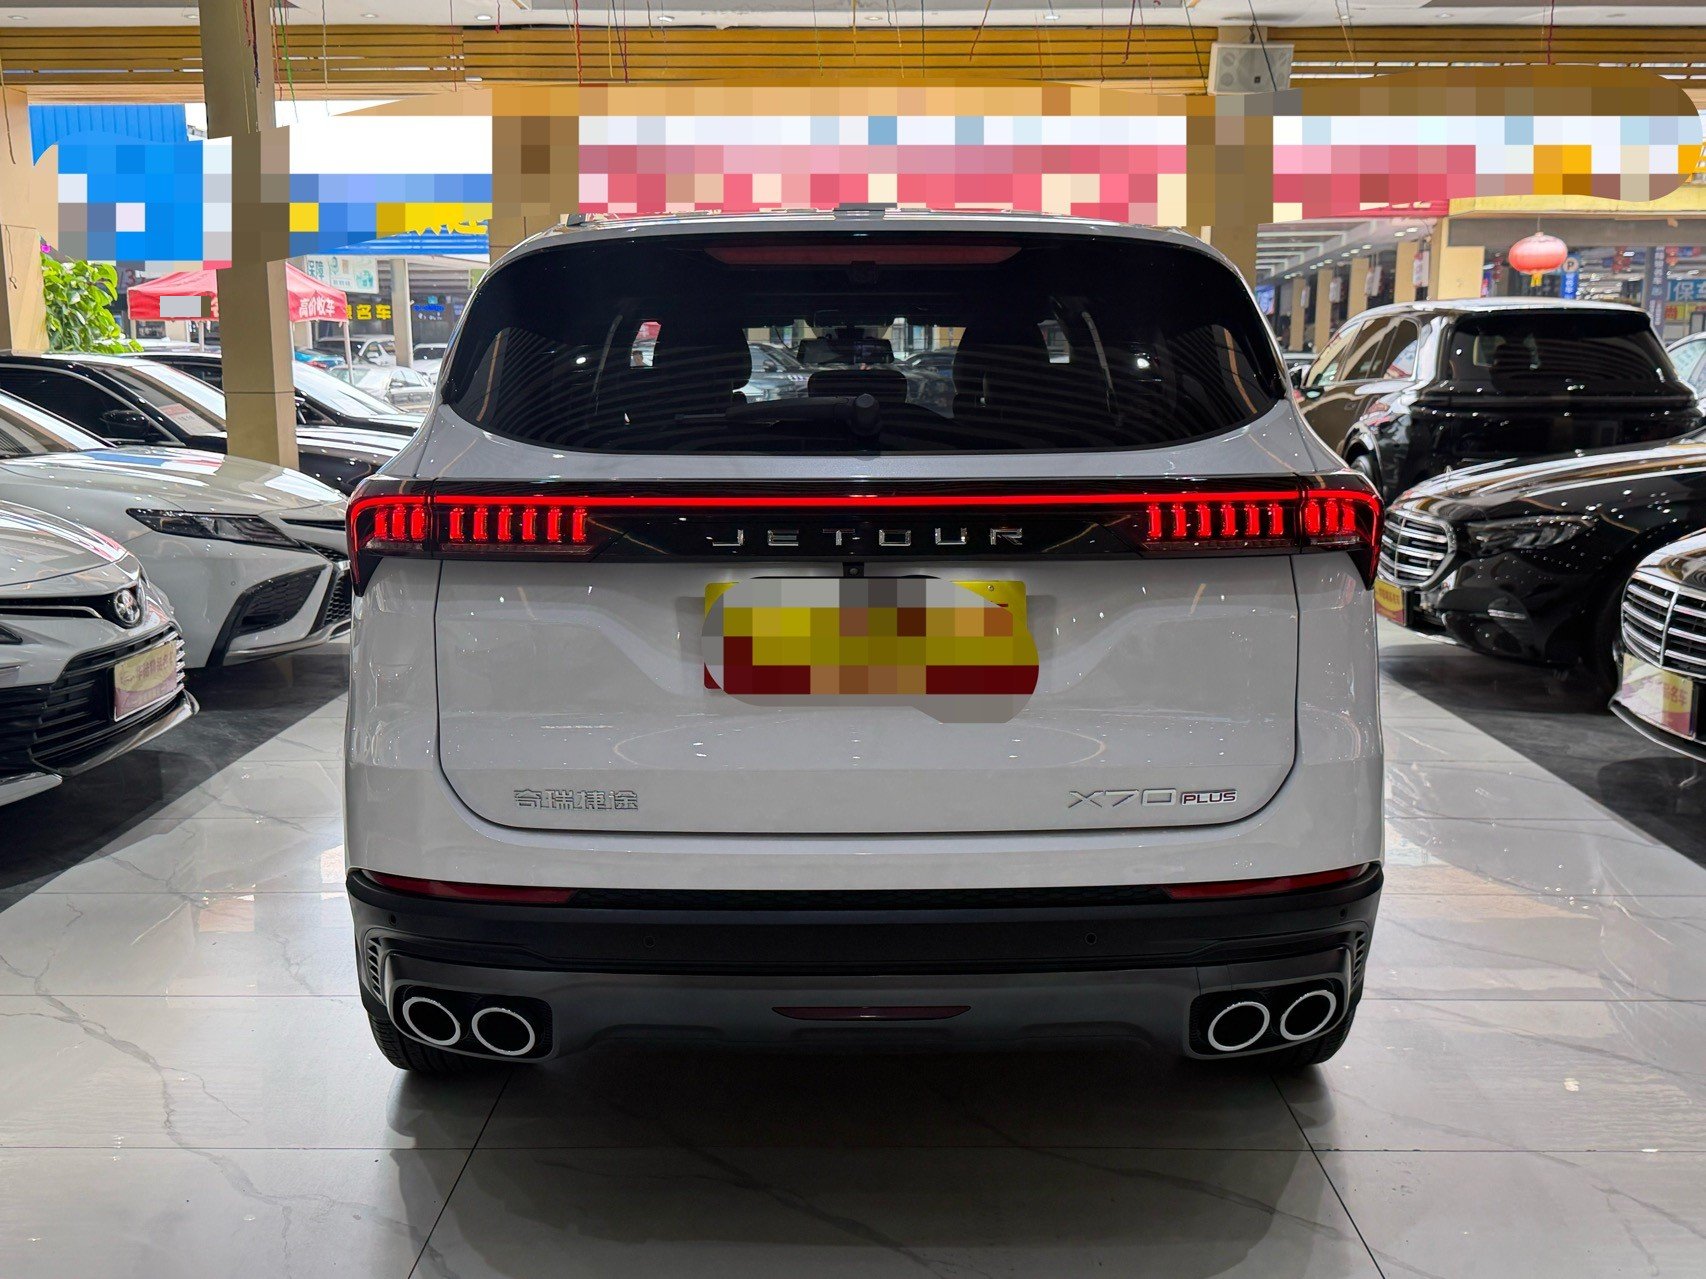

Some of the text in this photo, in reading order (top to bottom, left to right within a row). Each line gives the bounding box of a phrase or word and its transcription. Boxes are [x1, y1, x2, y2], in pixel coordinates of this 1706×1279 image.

[299, 296, 335, 317] 高价收车
[707, 527, 1023, 547] JETOUR
[513, 788, 639, 810] 奇瑞捷途
[1068, 788, 1237, 808] X70 PLUS
